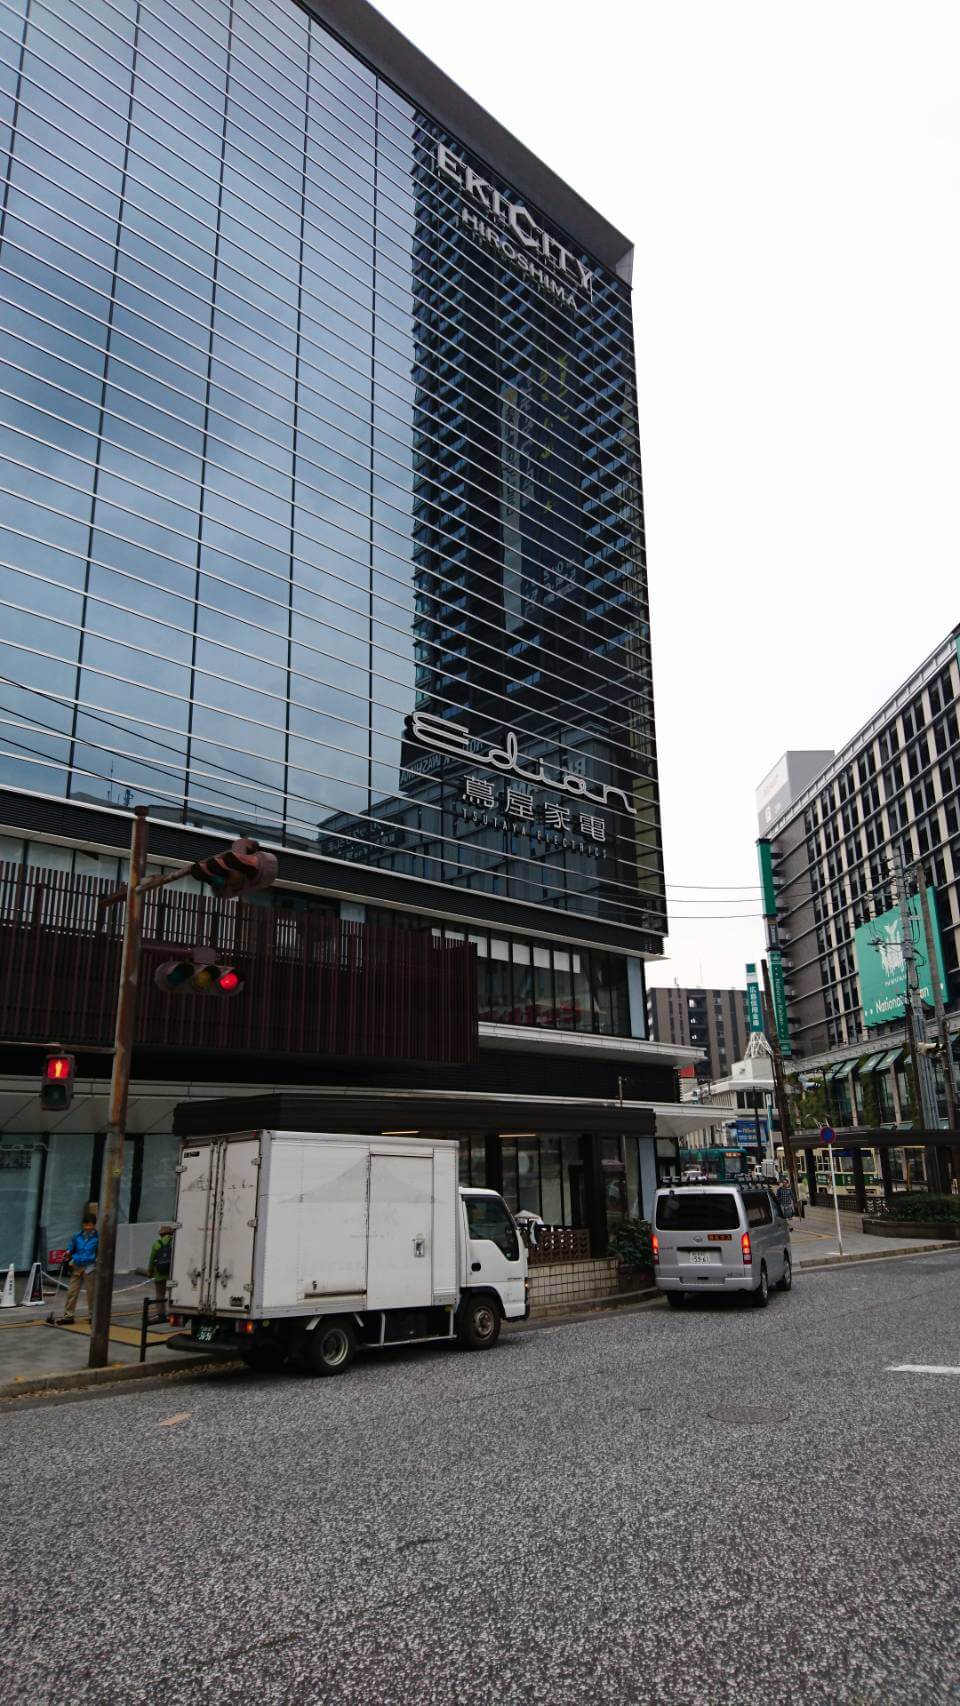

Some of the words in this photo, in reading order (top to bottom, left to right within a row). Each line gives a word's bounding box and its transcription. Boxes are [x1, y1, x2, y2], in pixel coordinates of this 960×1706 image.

[461, 206, 578, 311] HIROSHIMA
[412, 711, 637, 814] Edion
[463, 775, 606, 842] 蔦屋家電
[463, 807, 526, 835] TSUTAYA
[537, 830, 607, 859] ELECTRICS
